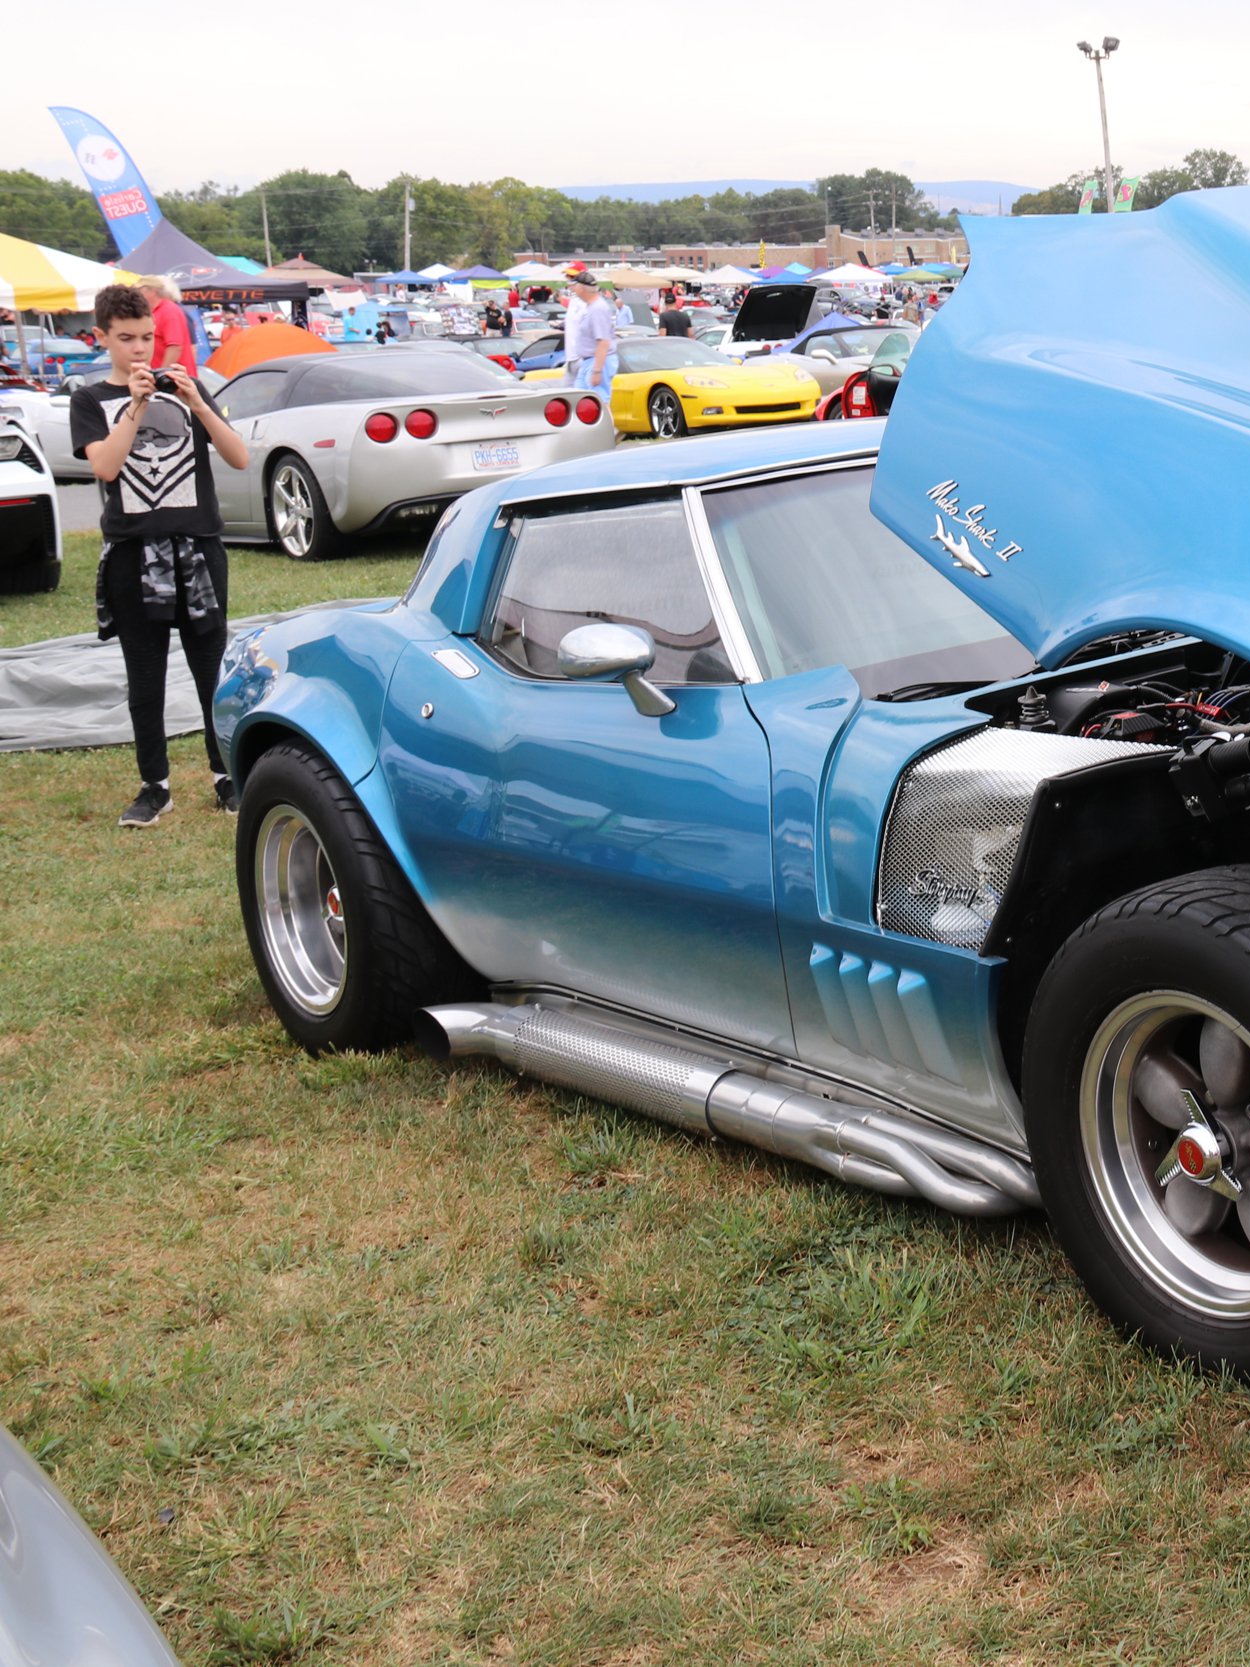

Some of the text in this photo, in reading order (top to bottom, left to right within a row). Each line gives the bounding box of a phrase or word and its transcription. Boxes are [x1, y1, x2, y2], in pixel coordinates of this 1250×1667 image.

[474, 447, 519, 464] PKH-6655
[926, 480, 1024, 562] Mako Shark II
[908, 868, 979, 908] Stingray
